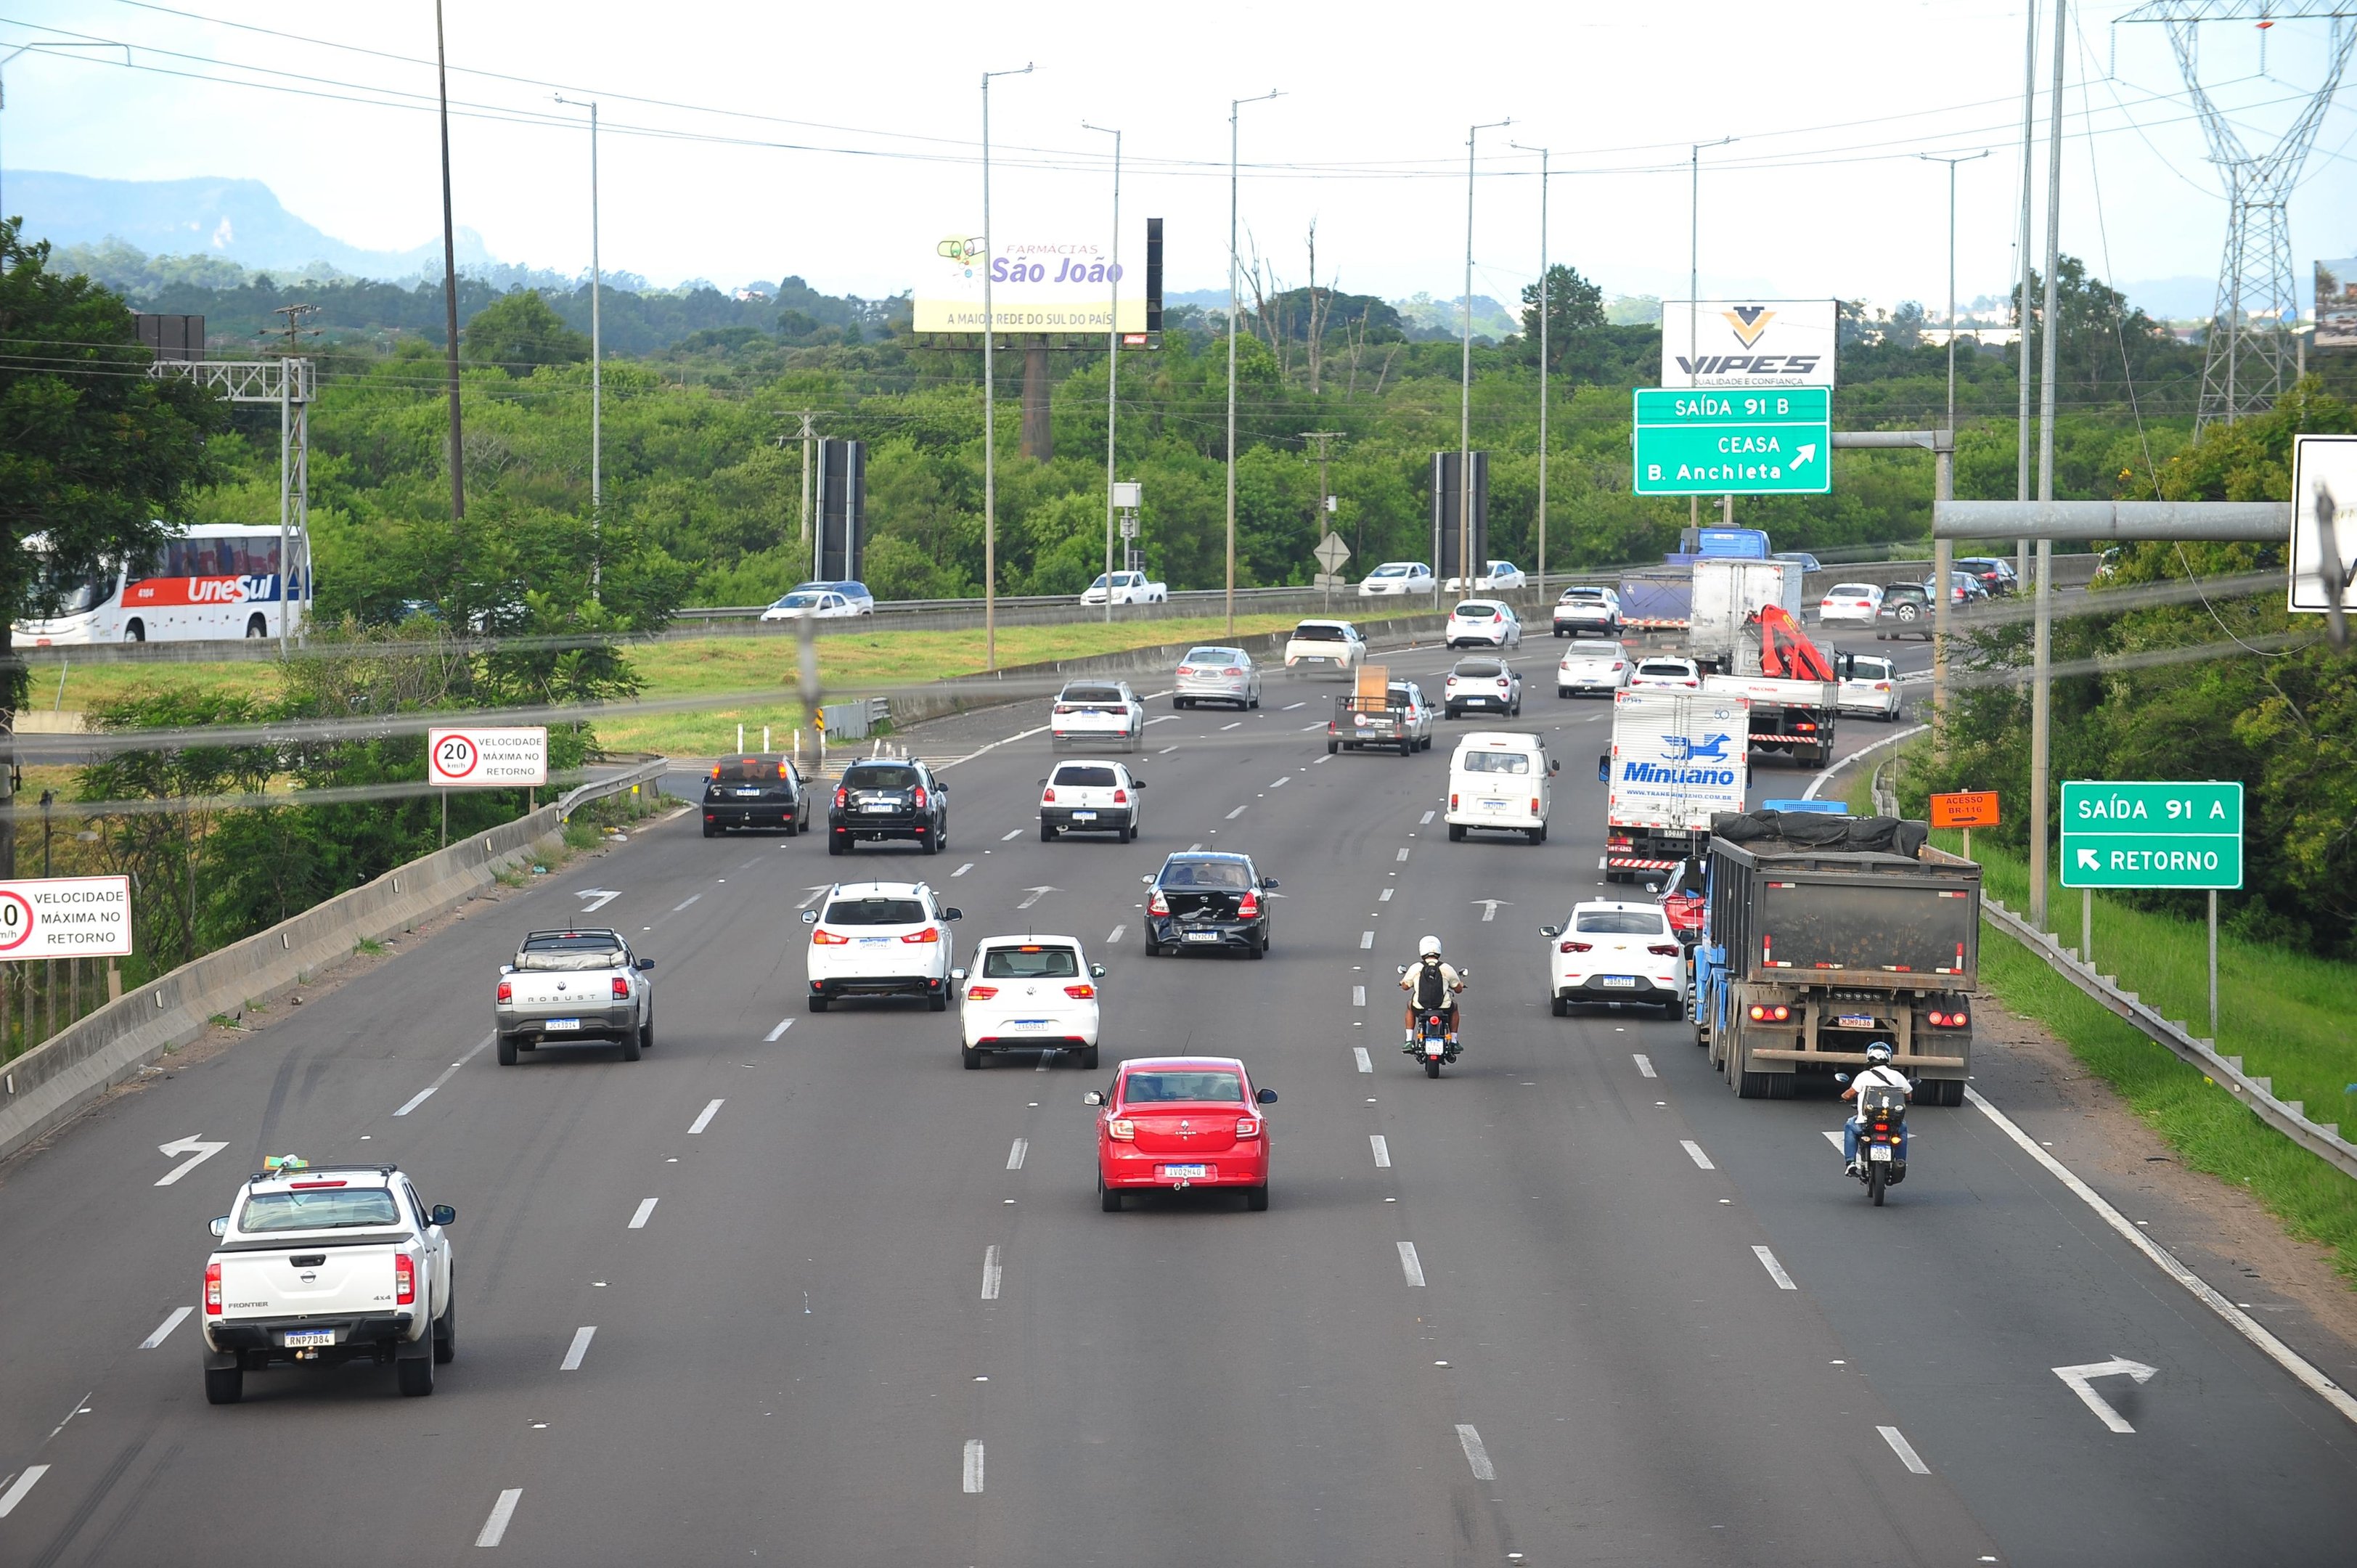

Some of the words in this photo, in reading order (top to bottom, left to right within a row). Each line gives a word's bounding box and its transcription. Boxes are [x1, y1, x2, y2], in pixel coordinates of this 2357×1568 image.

[1006, 244, 1098, 254] FARMÁCIAS
[990, 256, 1045, 283] São
[1054, 256, 1123, 283] João
[947, 314, 955, 324] A
[997, 314, 1024, 324] REDE
[1027, 314, 1043, 324] DO
[1047, 314, 1066, 324] SUL
[1070, 314, 1086, 324] DO
[1090, 311, 1113, 324] PAÍS
[1675, 356, 1821, 374] VIPES
[1752, 377, 1804, 386] CONFIANÇA
[1675, 394, 1732, 416] SAÍDA
[1744, 399, 1766, 415] 91
[1777, 398, 1789, 415] B
[1717, 436, 1781, 453] CEASA
[1647, 464, 1667, 481] B.
[1676, 463, 1781, 480] Anchieta
[187, 574, 274, 603] UneSul
[1714, 709, 1730, 719] 50
[444, 743, 467, 760] 20
[483, 751, 522, 761] MÁXIMA
[1623, 762, 1734, 785] Minuano
[2078, 793, 2148, 820] SAÍDA
[2165, 799, 2191, 820] 91
[2209, 800, 2226, 820] A
[2110, 851, 2218, 870] RETORNO
[34, 891, 124, 904] VELOCIDADE
[0, 904, 17, 926] 0
[41, 911, 97, 924] MÁXIMA
[101, 912, 120, 922] NO
[0, 930, 17, 939] m/h
[48, 932, 115, 944] RETORNO
[290, 1335, 330, 1345] RNP7D84
